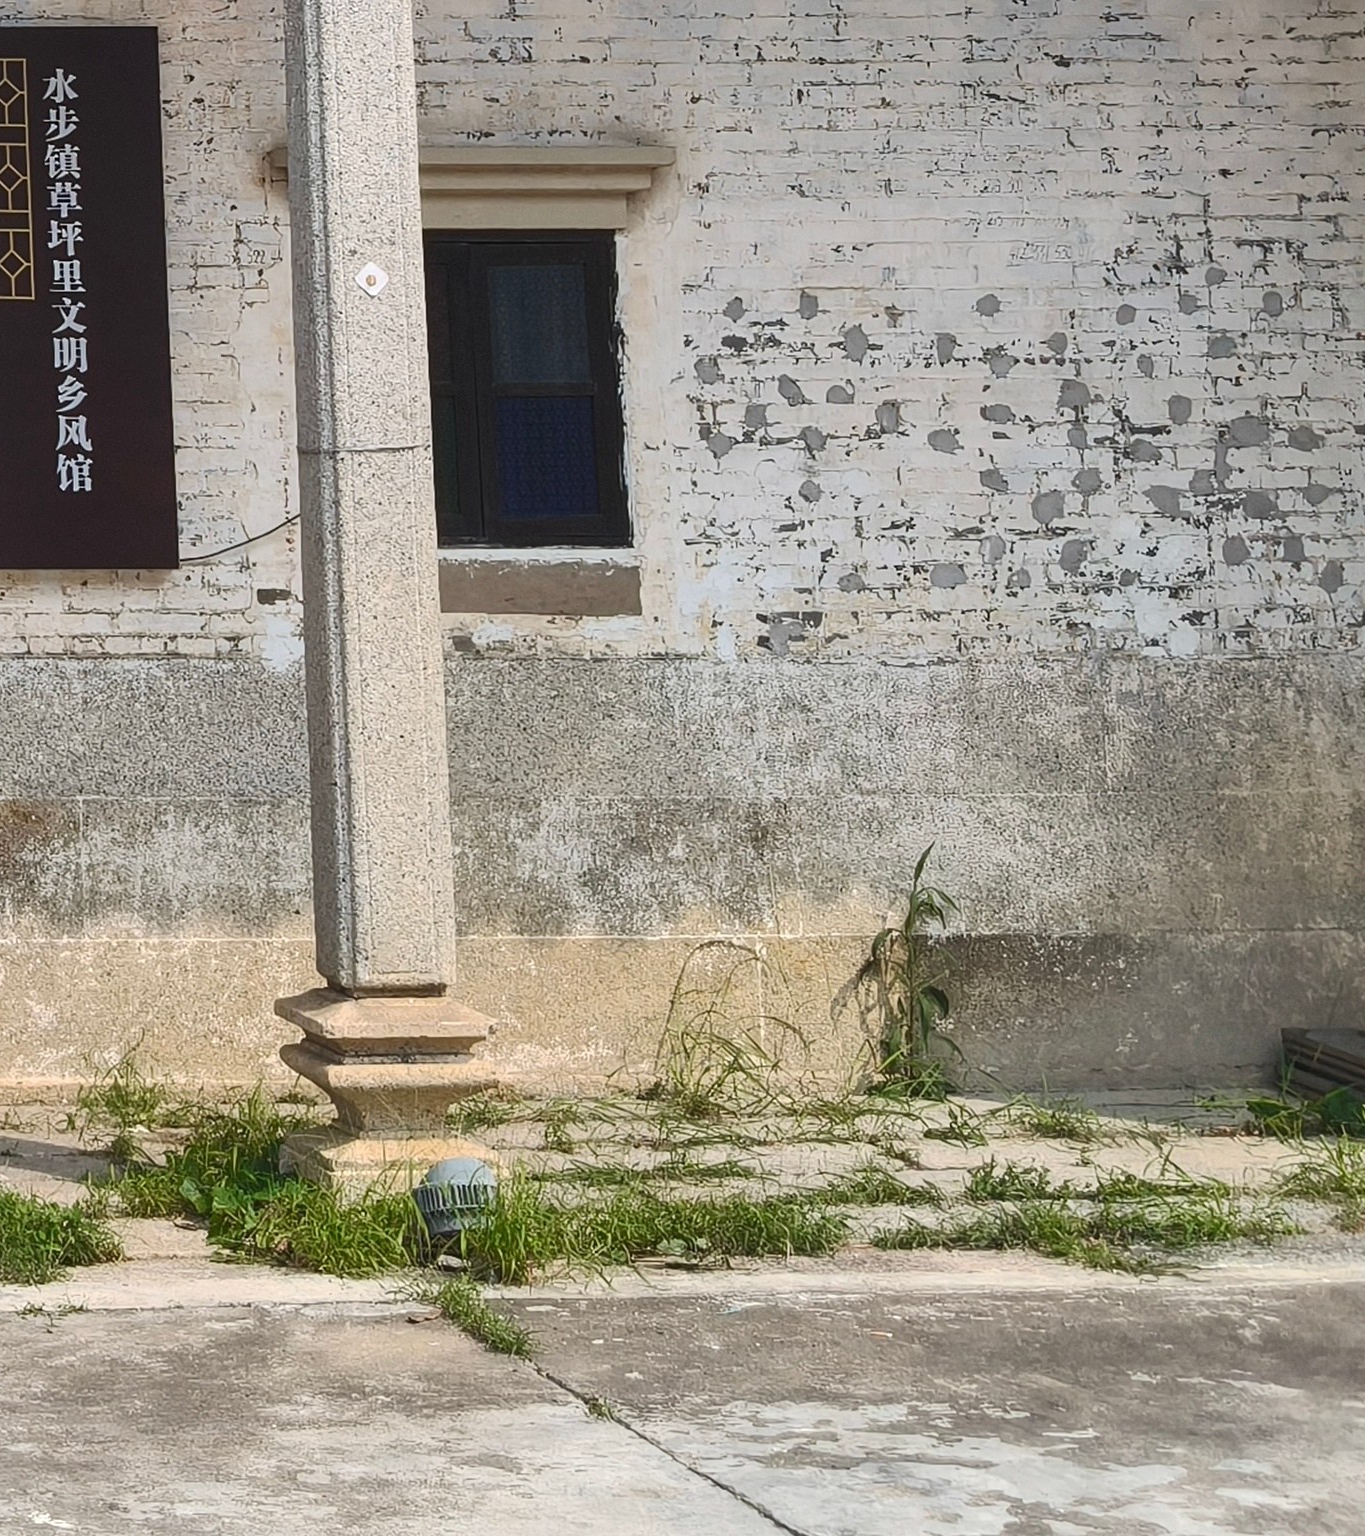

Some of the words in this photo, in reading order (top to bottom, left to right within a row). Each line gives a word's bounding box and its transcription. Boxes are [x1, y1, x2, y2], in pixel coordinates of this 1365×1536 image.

[42, 68, 93, 492] 水步镇草坪里文明乡风馆
